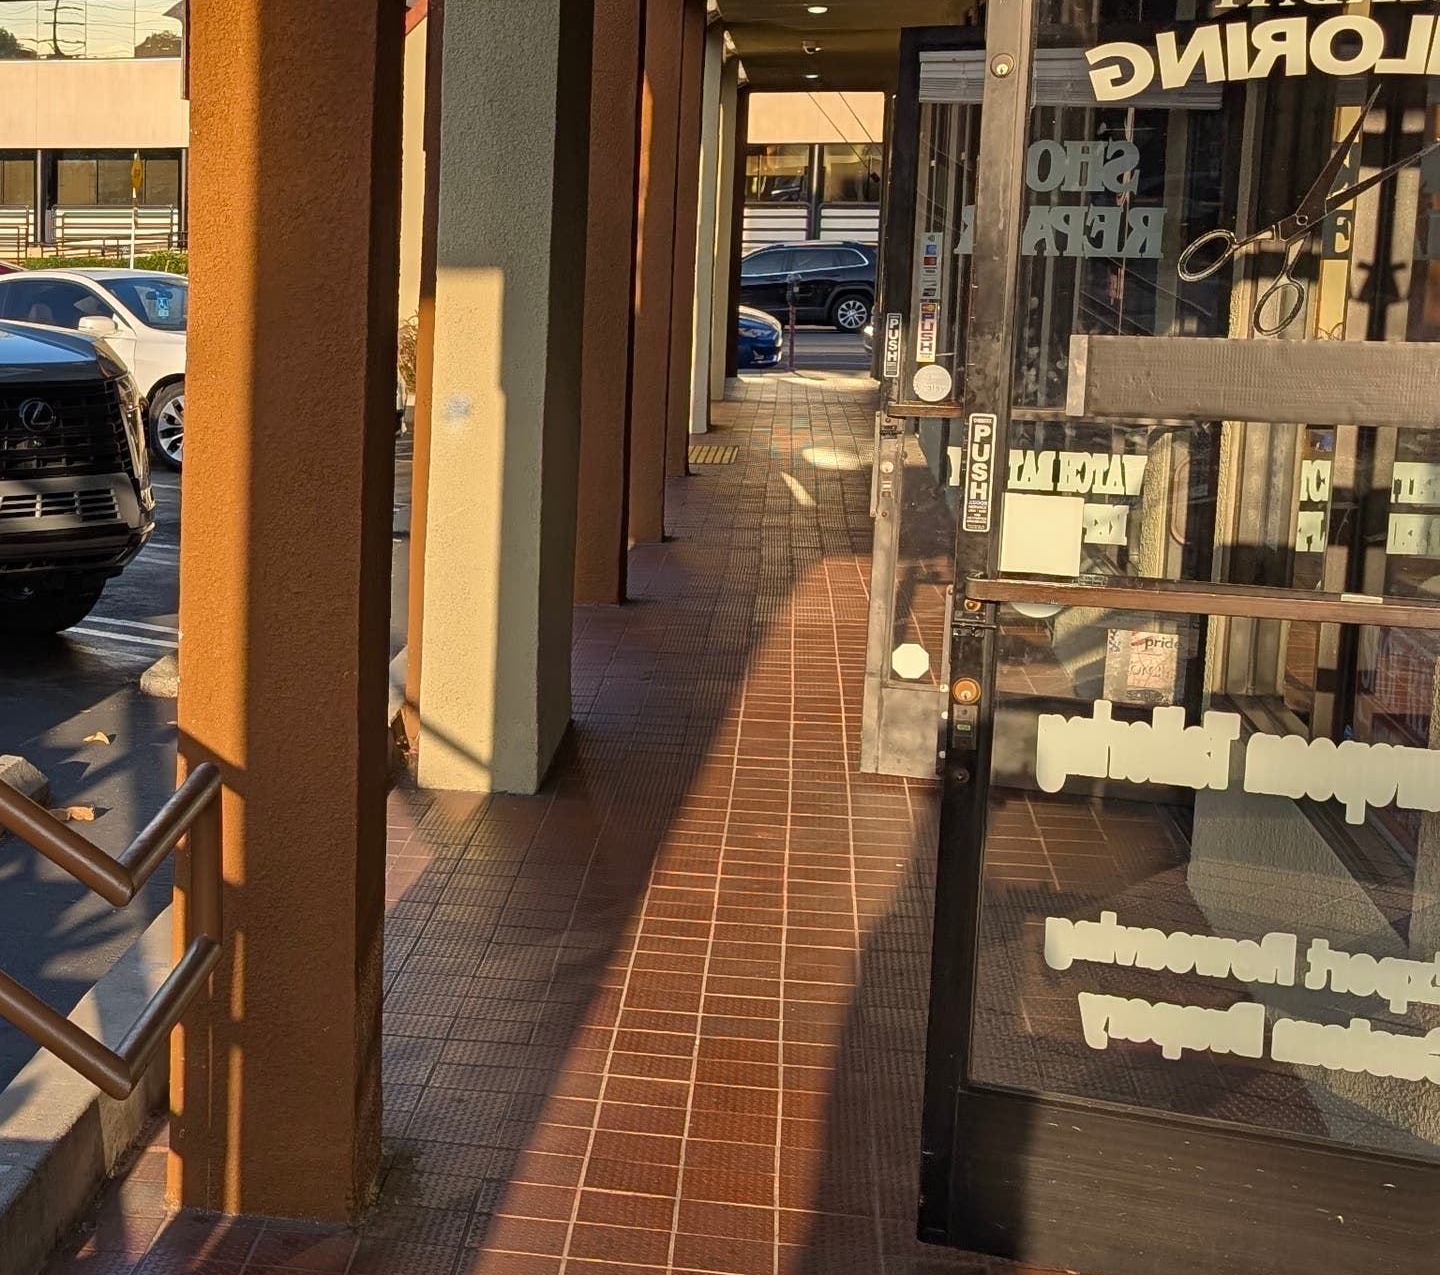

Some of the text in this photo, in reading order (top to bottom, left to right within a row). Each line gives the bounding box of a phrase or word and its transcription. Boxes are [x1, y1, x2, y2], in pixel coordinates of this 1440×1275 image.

[887, 318, 899, 362] PUSH
[920, 315, 935, 352] USH
[969, 424, 992, 500] PUSH
